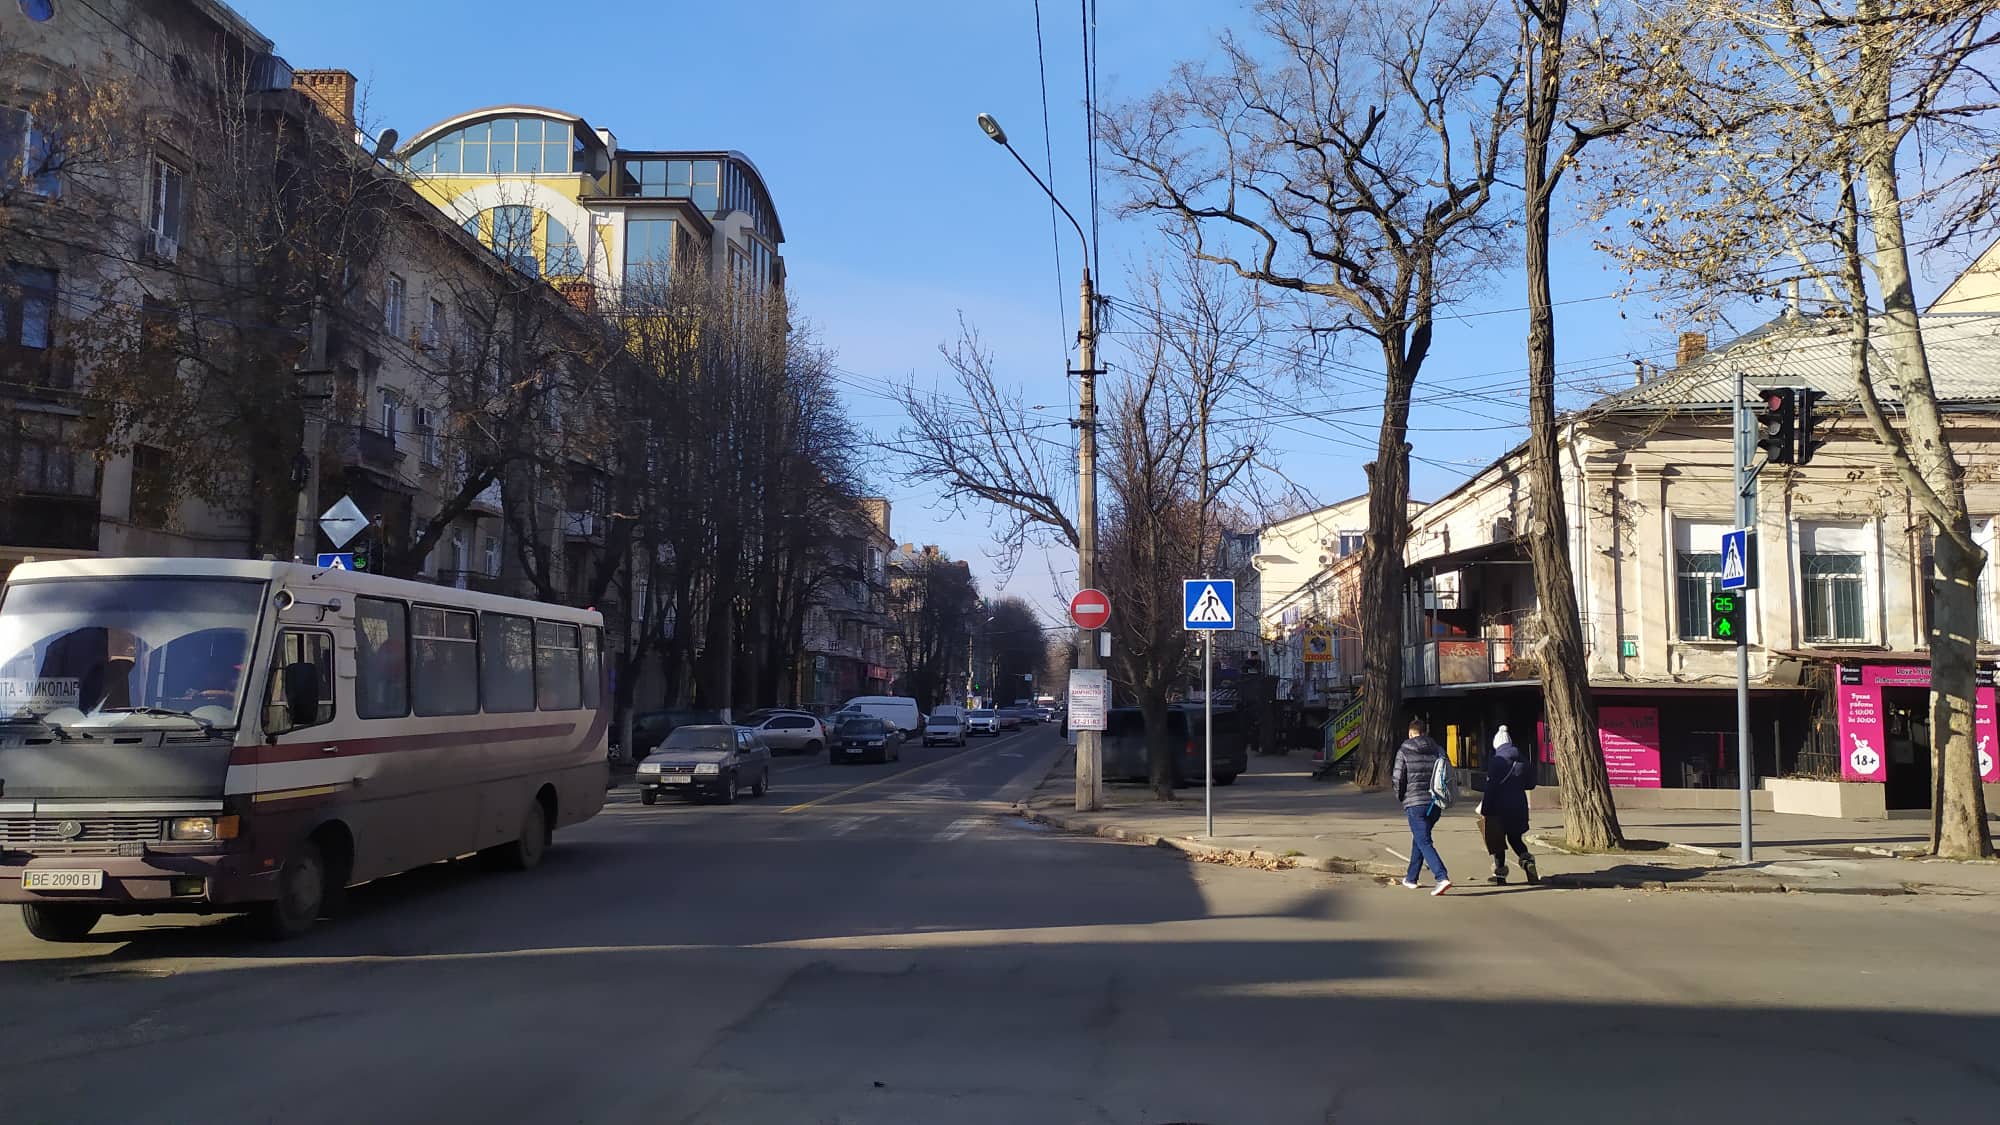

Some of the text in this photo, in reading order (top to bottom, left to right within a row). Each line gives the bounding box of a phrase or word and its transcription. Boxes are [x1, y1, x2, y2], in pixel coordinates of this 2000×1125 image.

[1715, 597, 1733, 611] 25
[1854, 754, 1877, 766] 18+
[32, 871, 49, 886] BE
[52, 871, 79, 886] 2090
